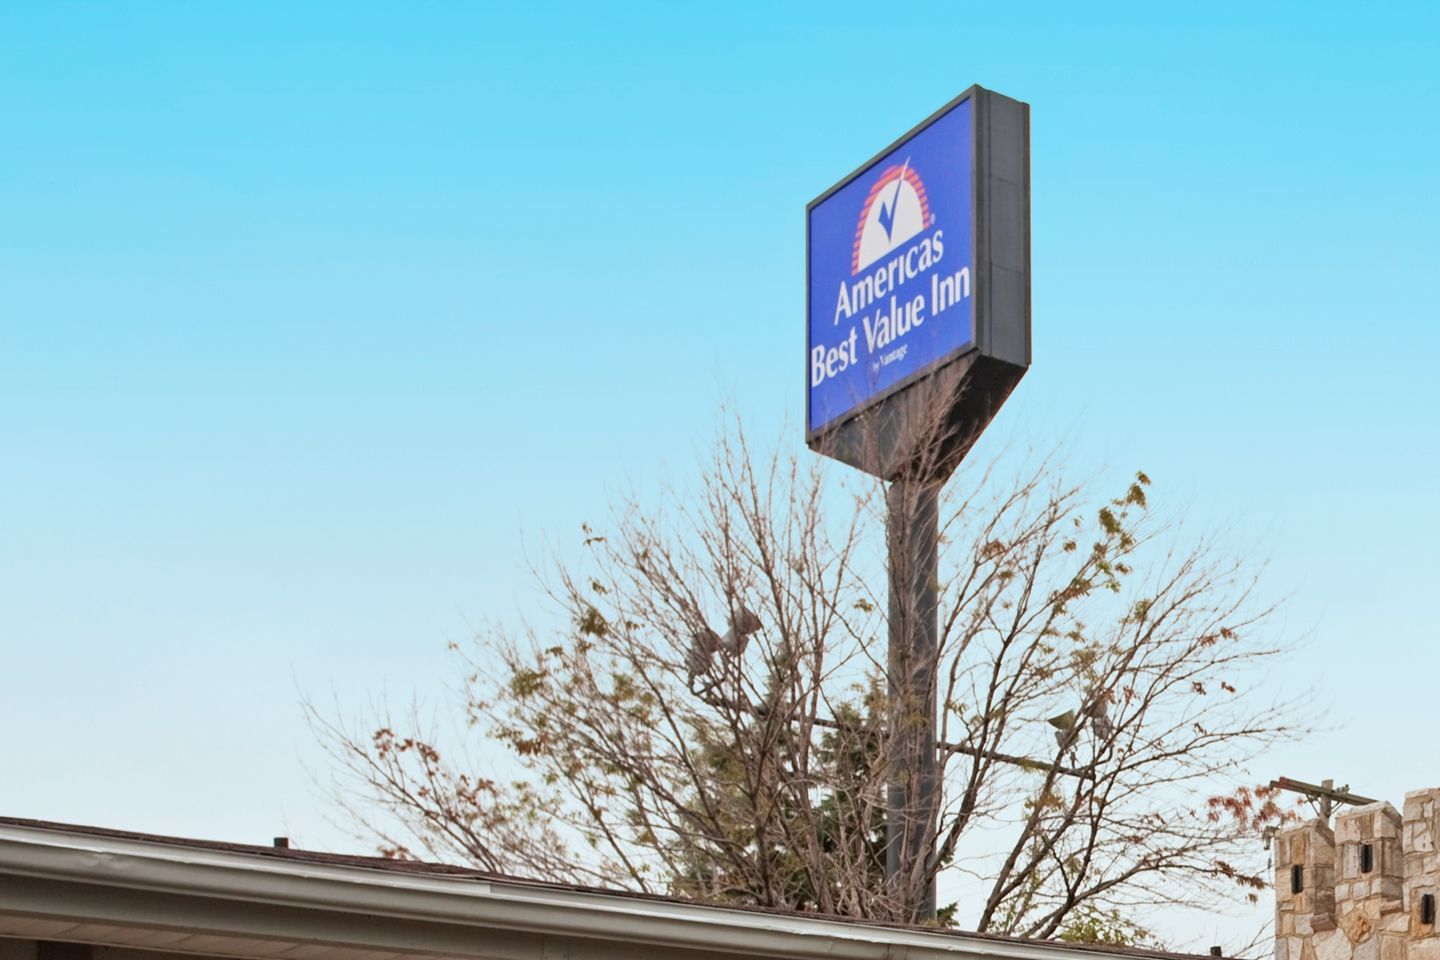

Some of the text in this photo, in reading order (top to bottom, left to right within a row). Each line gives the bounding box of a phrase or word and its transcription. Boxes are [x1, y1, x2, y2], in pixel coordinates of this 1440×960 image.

[811, 266, 971, 388] Best Value Inn
[834, 230, 944, 326] Americas
